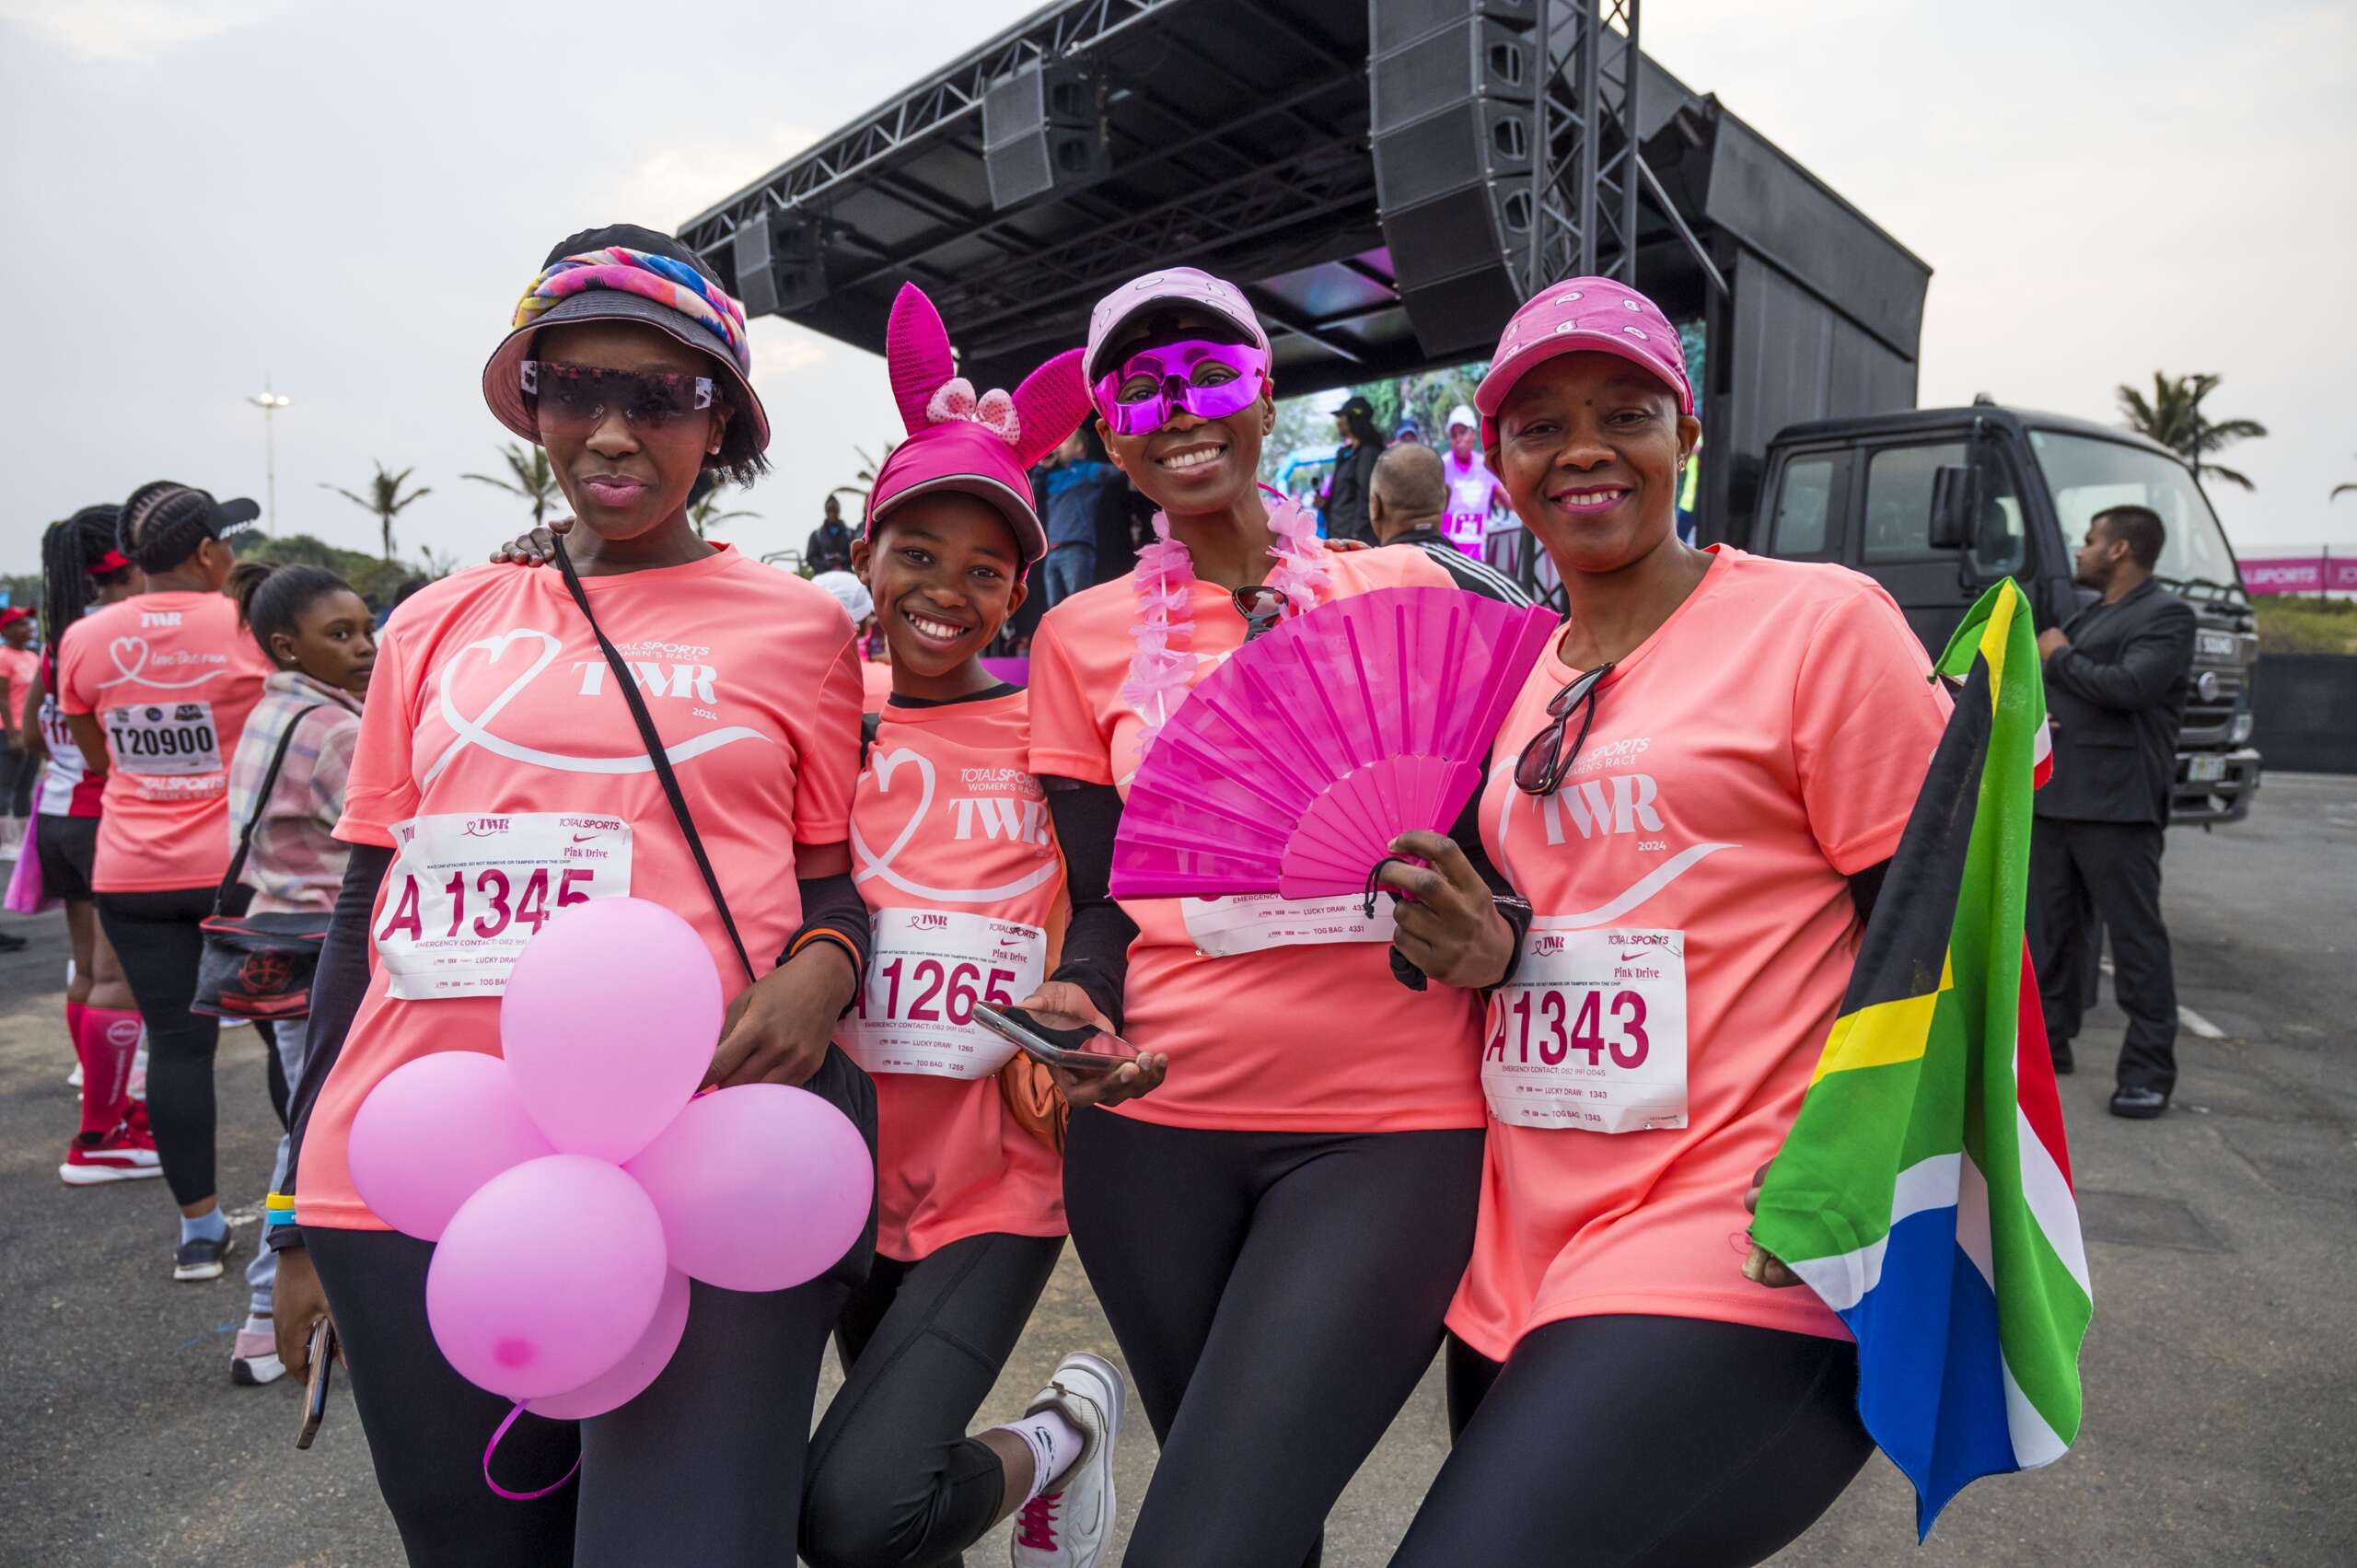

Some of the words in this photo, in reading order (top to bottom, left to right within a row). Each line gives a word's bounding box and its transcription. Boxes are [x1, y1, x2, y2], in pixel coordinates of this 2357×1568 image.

[666, 652, 701, 661] RACE
[571, 661, 718, 705] TWR
[691, 707, 718, 721] 2024
[110, 726, 214, 756] T20900
[1605, 755, 1637, 767] RACE
[968, 783, 1016, 791] WOMEN'S
[1532, 773, 1666, 845] TWR
[478, 819, 510, 830] TWR
[559, 819, 621, 830] TOTALSPORTS
[947, 797, 1050, 846] TWR
[1637, 841, 1666, 852] 2024
[563, 847, 583, 858] Pink
[586, 848, 608, 859] Drive
[1233, 893, 1279, 903] EMERGENCY
[1304, 906, 1325, 915] LUCKY
[921, 914, 947, 926] TWR
[415, 940, 458, 948] EMERGENCY
[1543, 935, 1565, 949] TWR
[1608, 935, 1668, 945] TOTALSPORTS
[992, 948, 1007, 959] Pink
[1009, 951, 1028, 963] Drive
[1614, 966, 1632, 978] Pink
[1635, 967, 1660, 979] Drive
[912, 1040, 933, 1048] LUCKY
[958, 1044, 974, 1053] 1265
[948, 1063, 965, 1072] 1265
[1502, 1064, 1530, 1074] EMERGENCY
[1545, 1086, 1563, 1096] LUCKY
[1589, 1090, 1608, 1099] 1343
[1551, 1109, 1566, 1118] TOG
[1585, 1114, 1602, 1122] 1343
